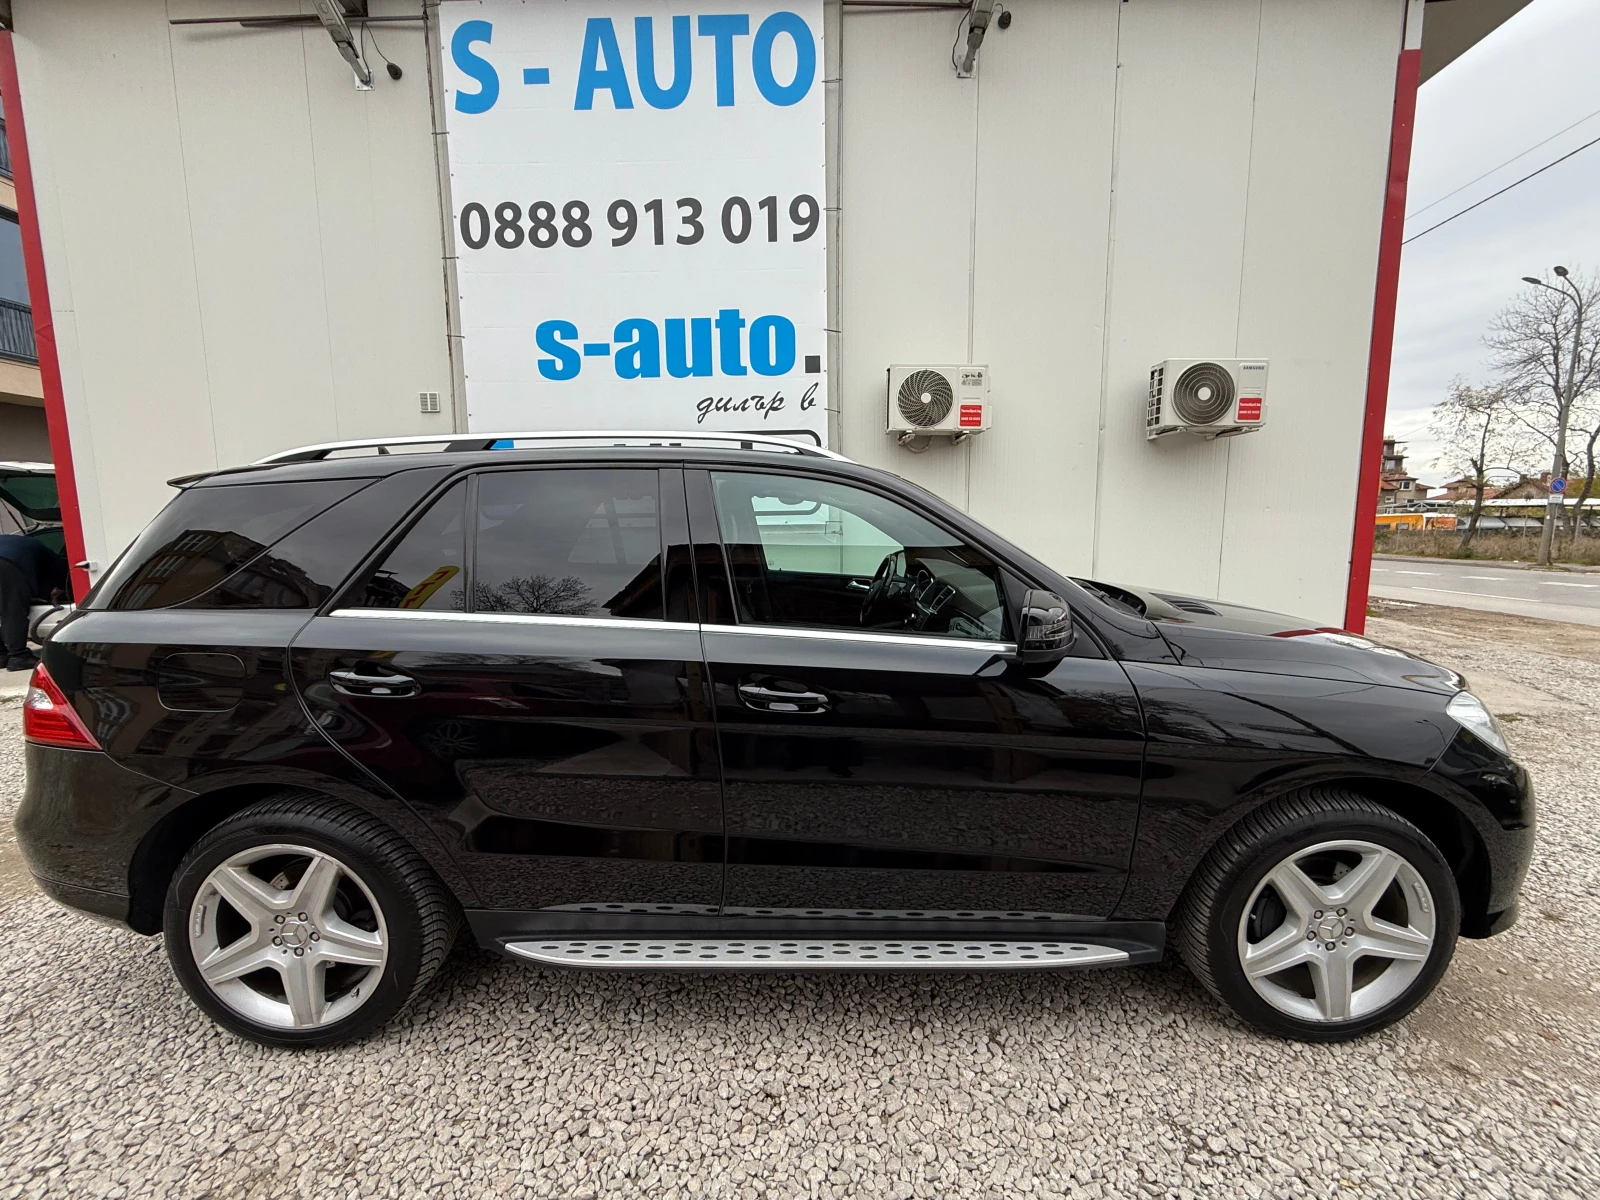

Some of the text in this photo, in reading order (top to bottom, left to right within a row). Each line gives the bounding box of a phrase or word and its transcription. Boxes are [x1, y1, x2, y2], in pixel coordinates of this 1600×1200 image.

[451, 20, 500, 114] S
[574, 11, 816, 111] AUTO
[460, 194, 820, 250] 0888 913 019
[696, 390, 786, 424] дилър
